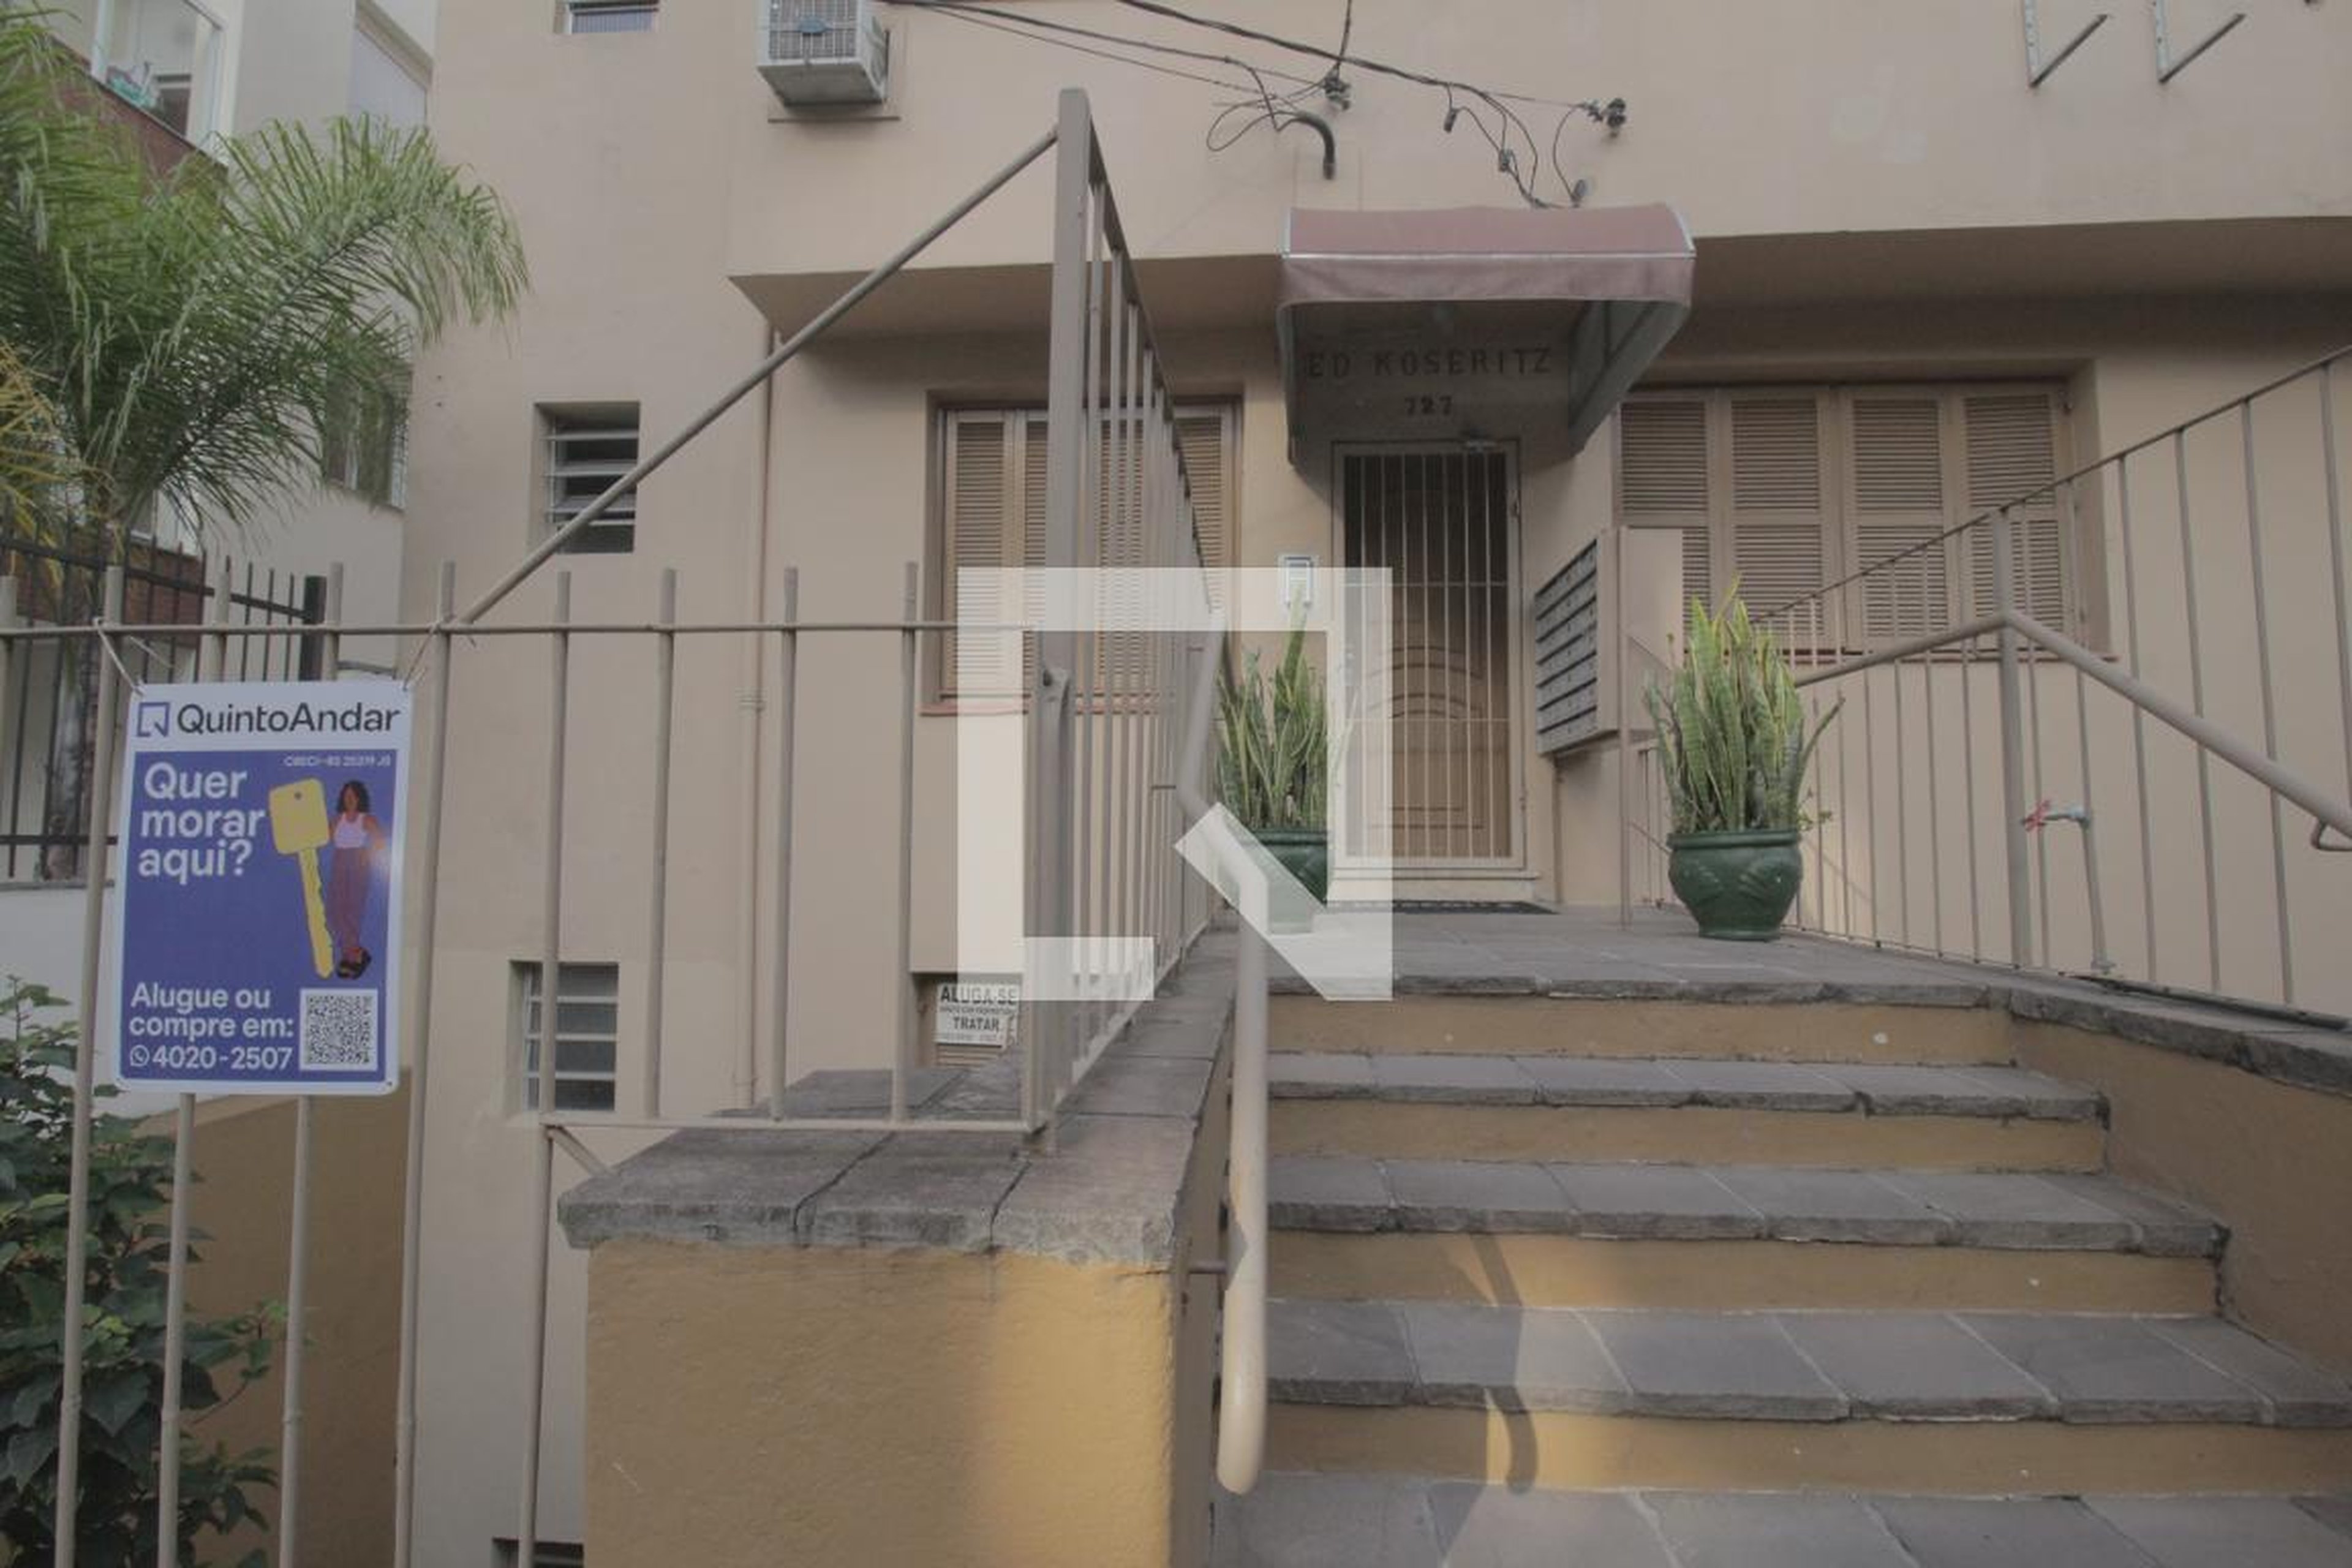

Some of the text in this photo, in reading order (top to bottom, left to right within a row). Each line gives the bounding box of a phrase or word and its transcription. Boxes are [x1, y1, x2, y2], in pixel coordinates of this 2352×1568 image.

[1306, 346, 1552, 379] ED KOSERITZ
[1404, 395, 1453, 416] 727
[178, 702, 401, 734] QuintoAndar
[144, 762, 247, 799] Quer
[140, 808, 265, 839] morar
[138, 840, 252, 886] aqui?
[130, 982, 270, 1014] Alugue ou
[129, 1016, 294, 1041] compre em:
[954, 1016, 999, 1031] TRATAR
[152, 1046, 293, 1070] 4020-2507
